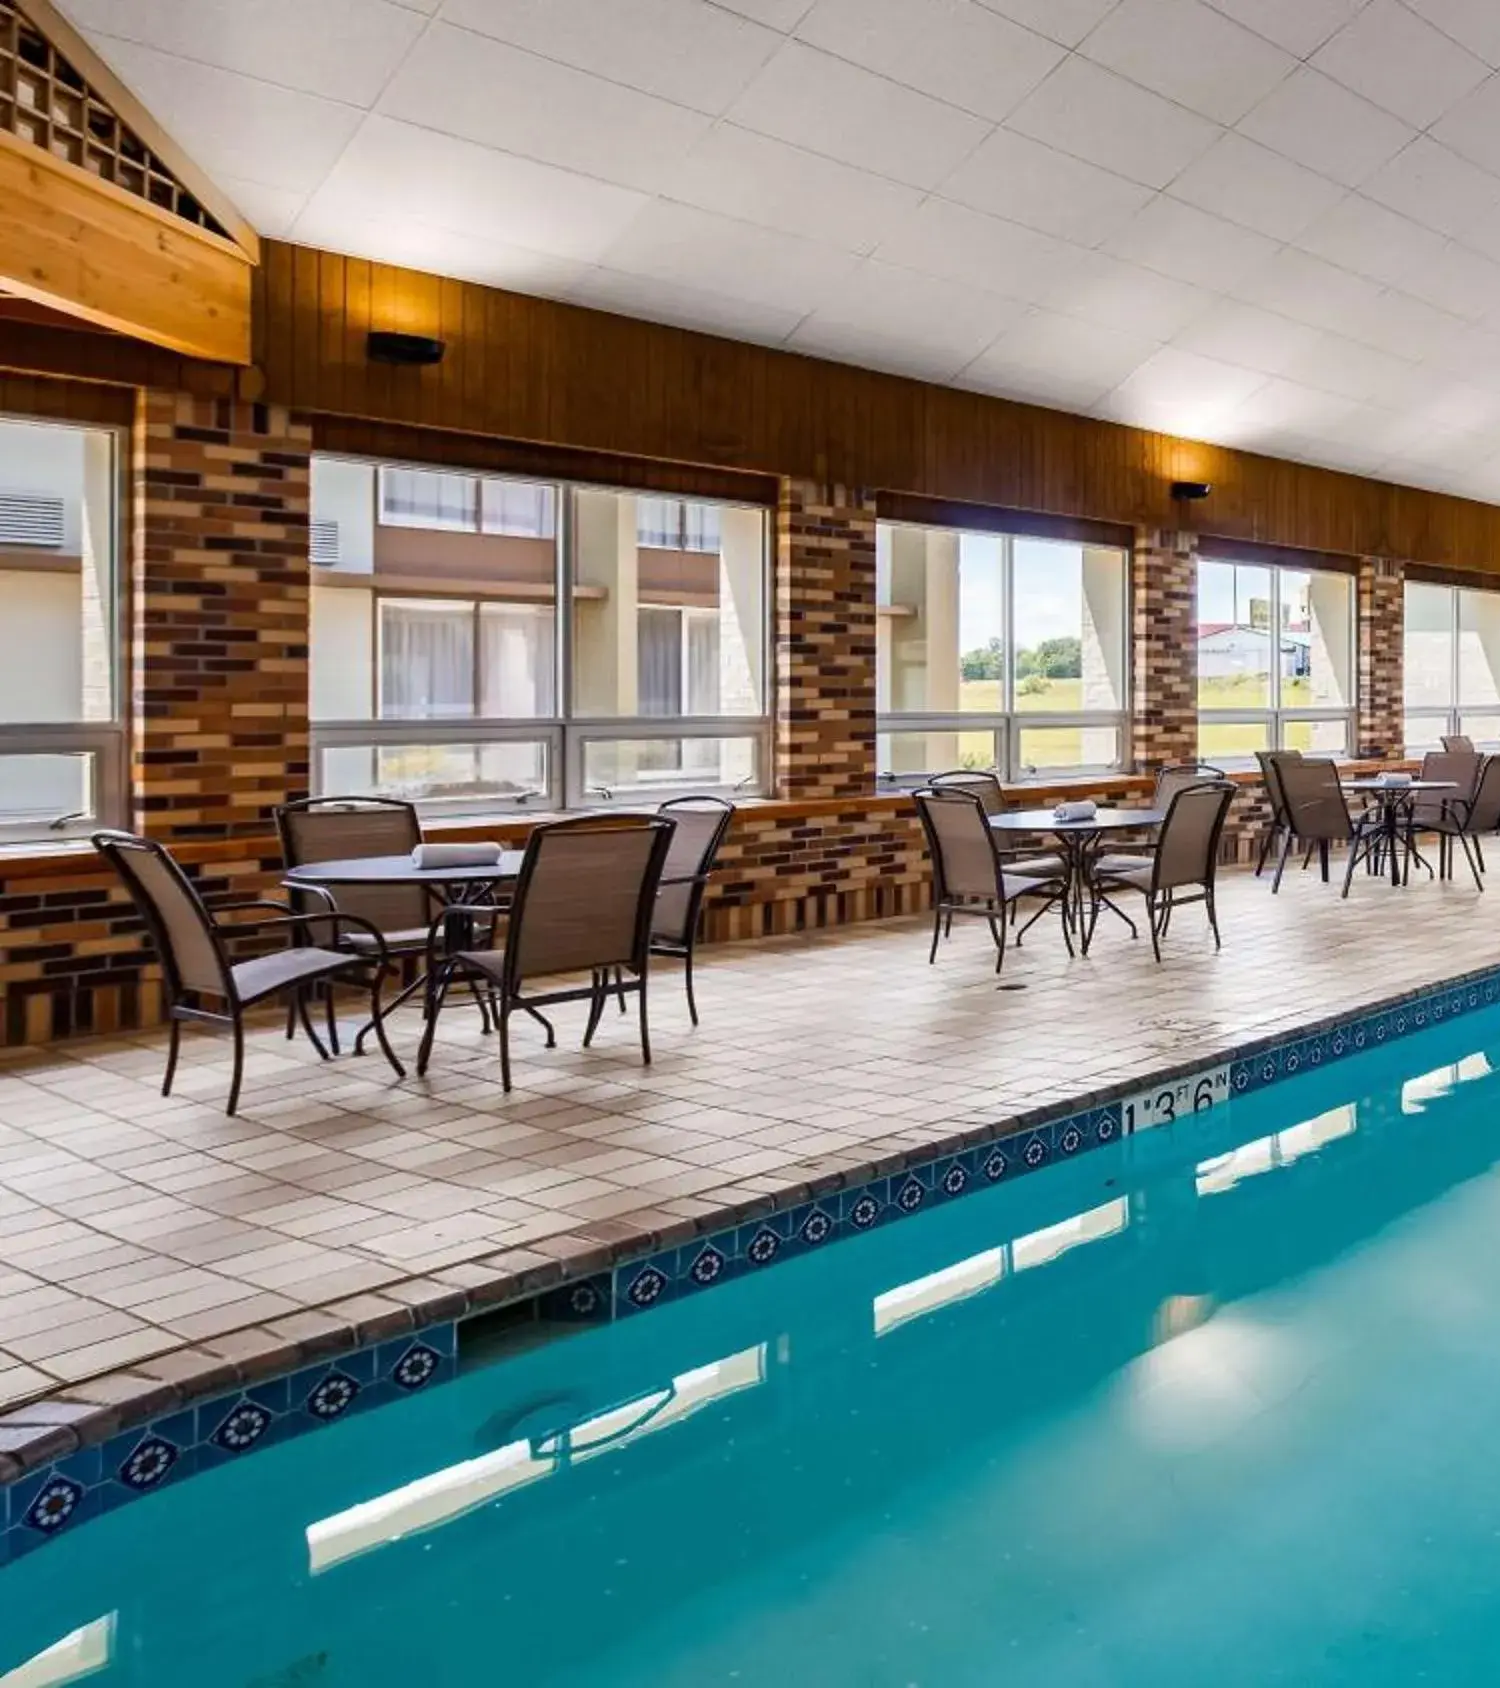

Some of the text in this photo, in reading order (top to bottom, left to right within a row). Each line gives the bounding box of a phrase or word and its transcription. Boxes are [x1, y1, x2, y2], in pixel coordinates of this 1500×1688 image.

[1125, 1103, 1135, 1135] 1
[1154, 1091, 1175, 1128] 3
[1176, 1084, 1189, 1102] FT
[1193, 1077, 1213, 1113] 6
[1215, 1071, 1227, 1088] IN
